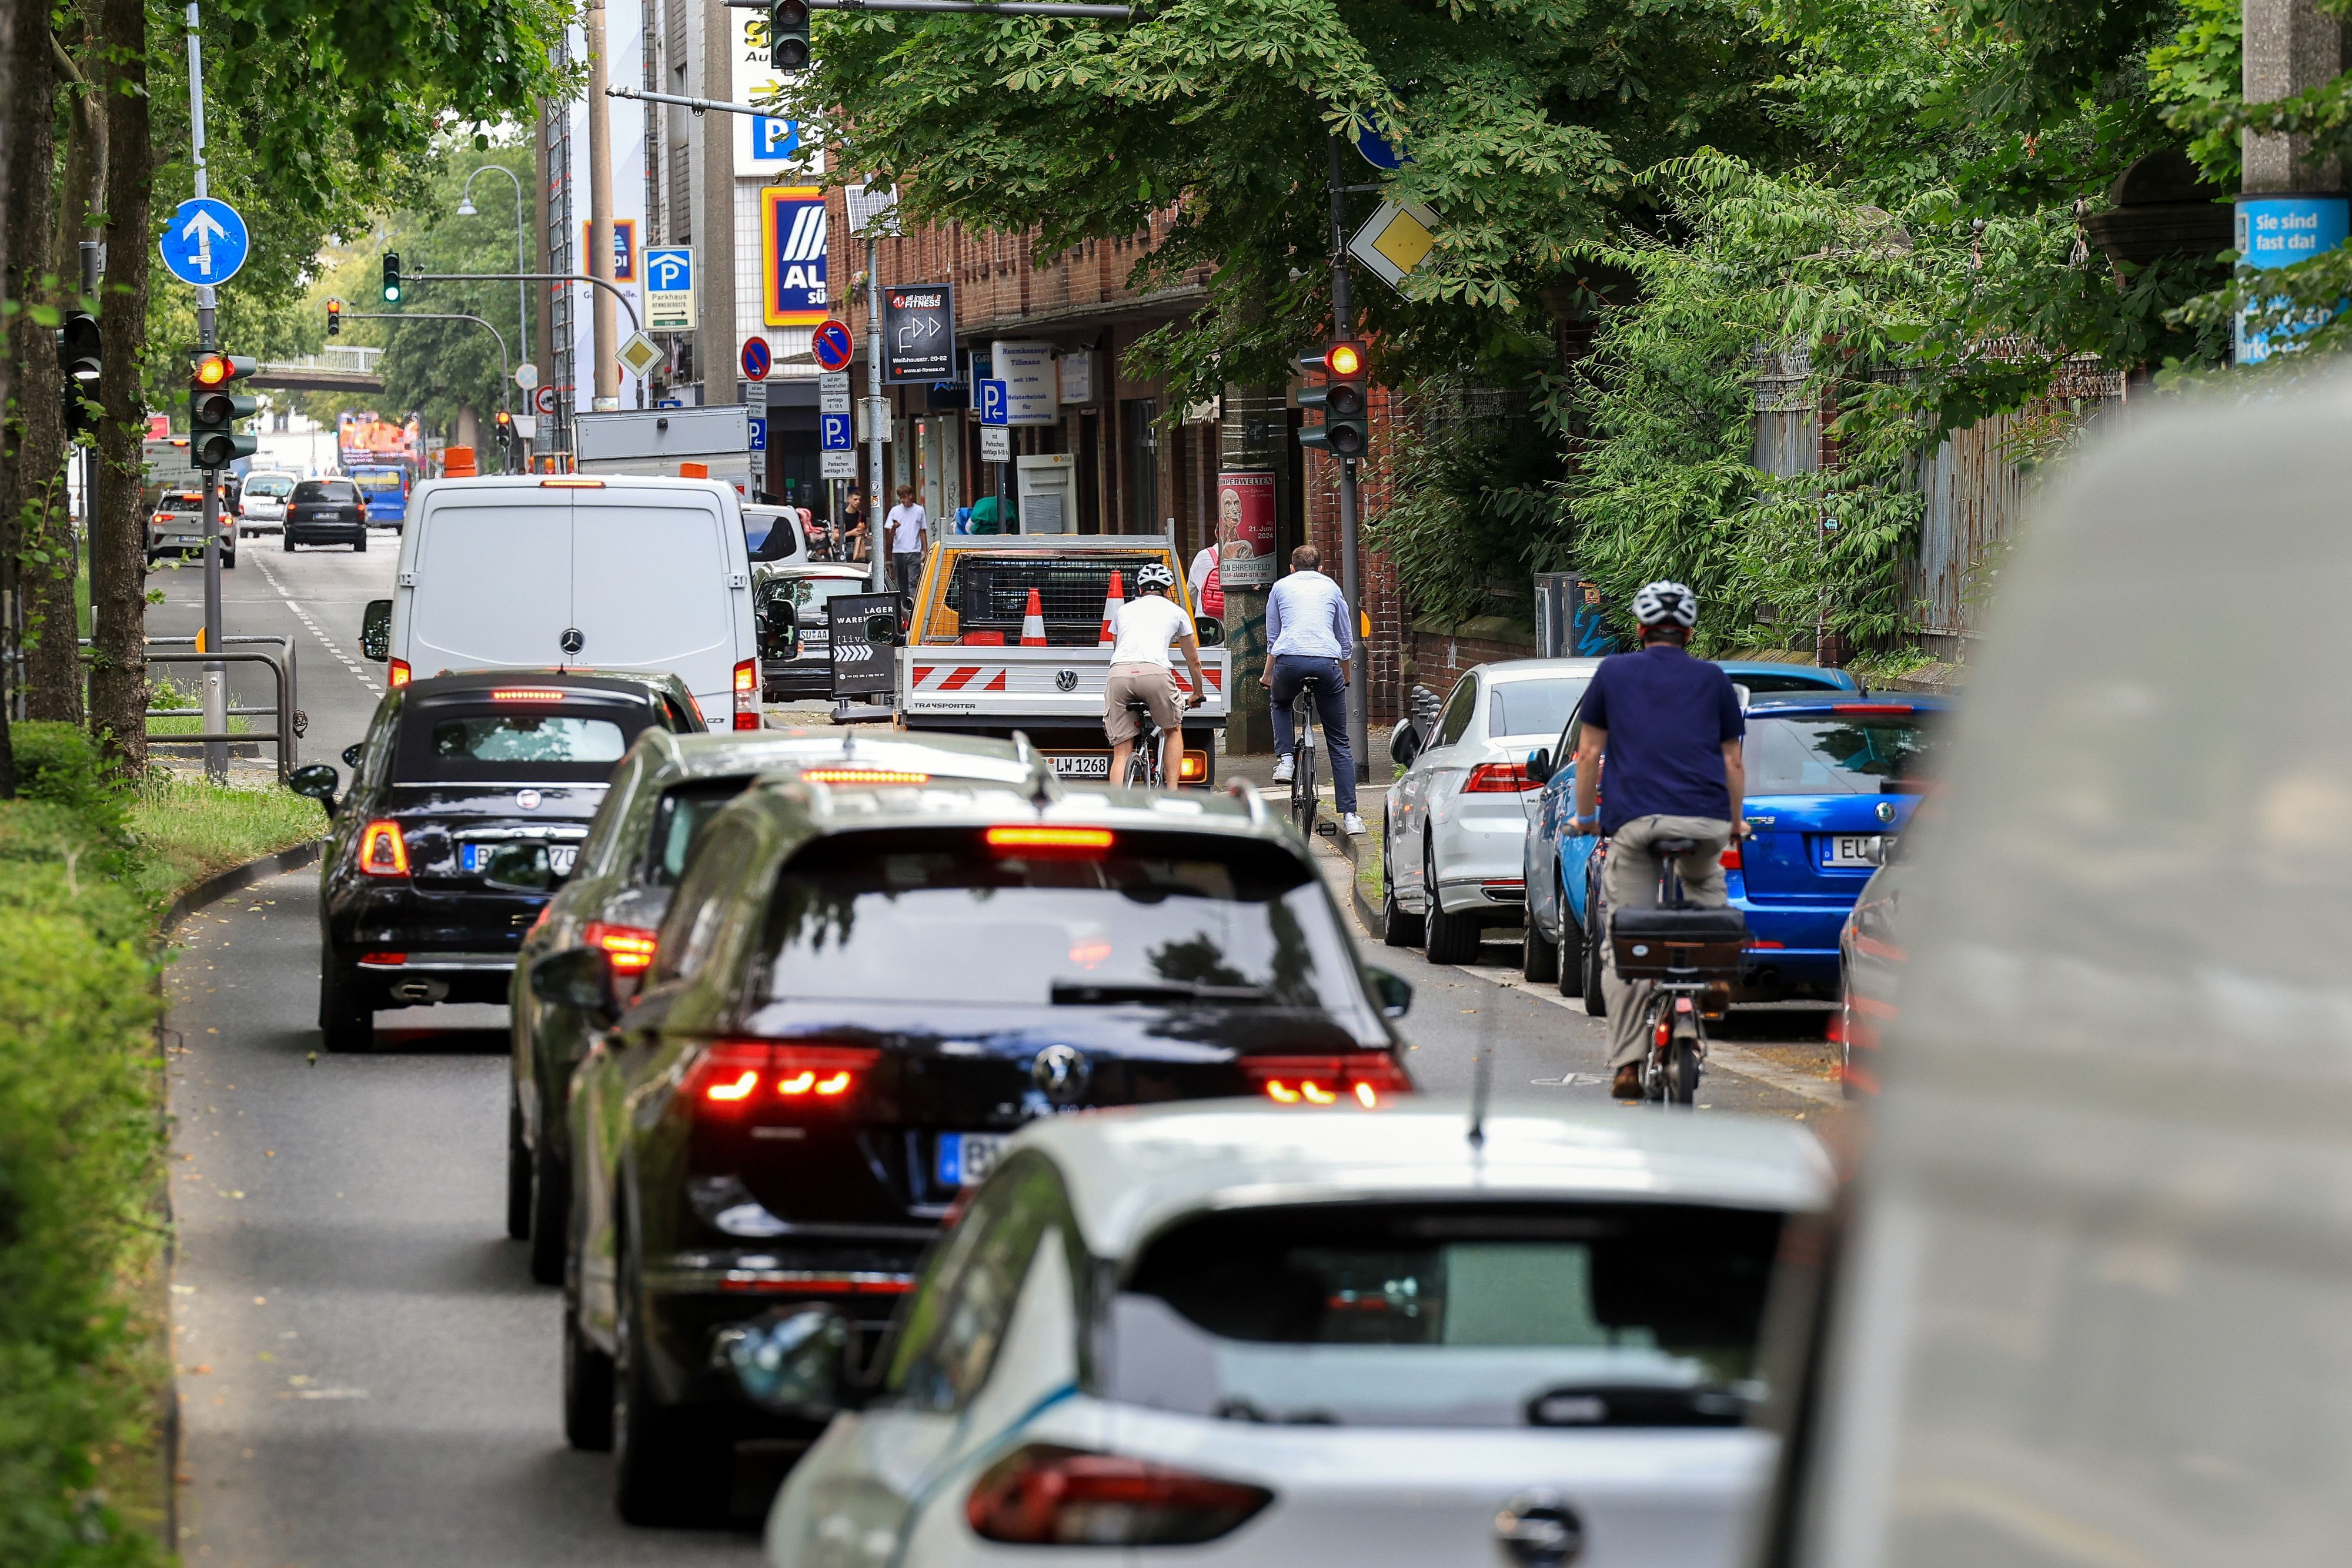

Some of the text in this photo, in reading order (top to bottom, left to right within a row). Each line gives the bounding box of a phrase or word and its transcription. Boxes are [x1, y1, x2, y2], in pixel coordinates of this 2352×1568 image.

[2256, 213, 2317, 230] Sie sind
[2256, 234, 2316, 250] fast da!
[614, 255, 627, 267] DI
[783, 265, 826, 289] AL
[808, 289, 827, 304] SÜ
[905, 299, 941, 308] FITNESS
[1220, 477, 1272, 486] ÖRPERWELTEN
[1221, 563, 1270, 572] ÖLN EHRENFELD
[837, 616, 868, 624] WAREH
[801, 630, 827, 639] SU AA
[1056, 758, 1105, 773] LW 1268
